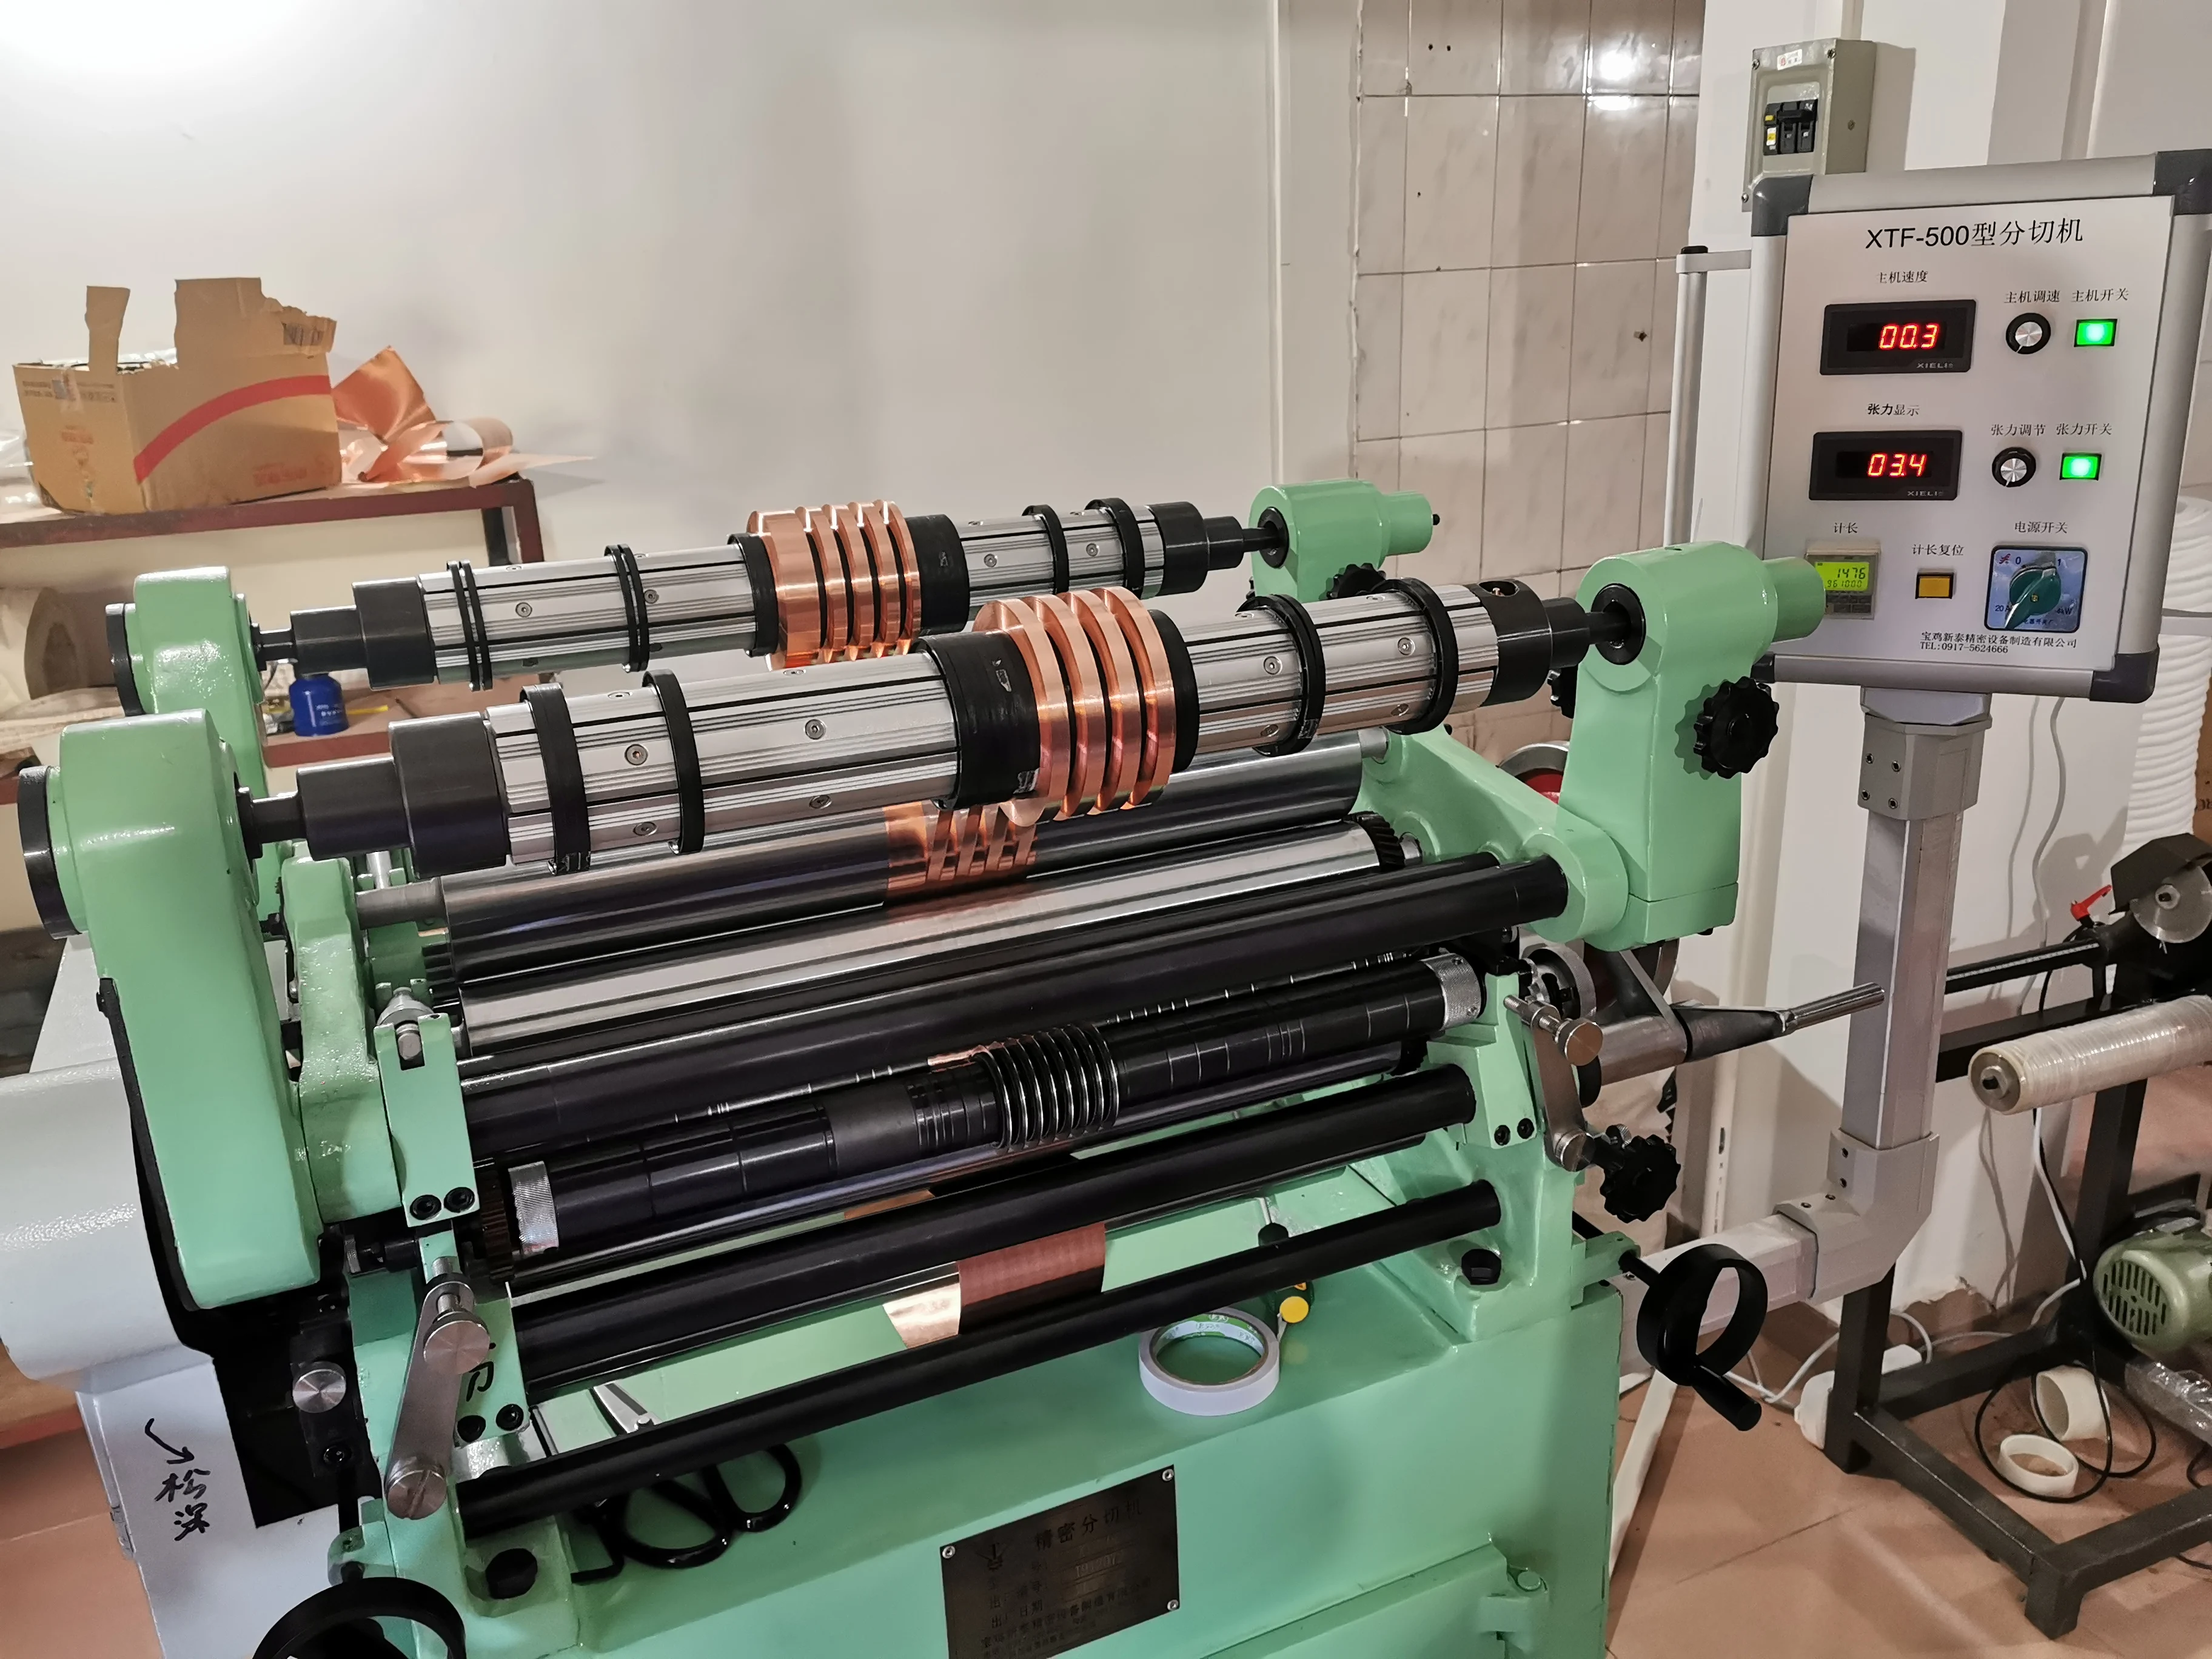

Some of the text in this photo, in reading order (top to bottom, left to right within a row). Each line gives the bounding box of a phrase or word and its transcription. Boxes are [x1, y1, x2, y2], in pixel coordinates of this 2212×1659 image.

[1866, 218, 2083, 249] XTF-500型分切机
[1876, 270, 1928, 283] 主机速度
[2004, 289, 2060, 303] 主机调速
[2071, 287, 2129, 302] 主机开关
[1879, 324, 1939, 349] 00.3
[1868, 403, 1920, 416] 张力显示
[1991, 423, 2046, 436] 张力调节
[2056, 423, 2113, 435] 张力开关
[1868, 454, 1927, 477] 03.4
[1834, 522, 1858, 534] 计长
[2014, 521, 2068, 534] 电源开关
[1911, 544, 1965, 556] 计长复位
[2015, 556, 2022, 565] 0
[1837, 567, 1866, 579] 1476
[1921, 631, 2077, 648] 宝鸡新泰精密设备制造有限公司
[1920, 641, 2008, 653] TEL:0917-5624666
[1034, 1498, 1142, 1552] 精密分切机
